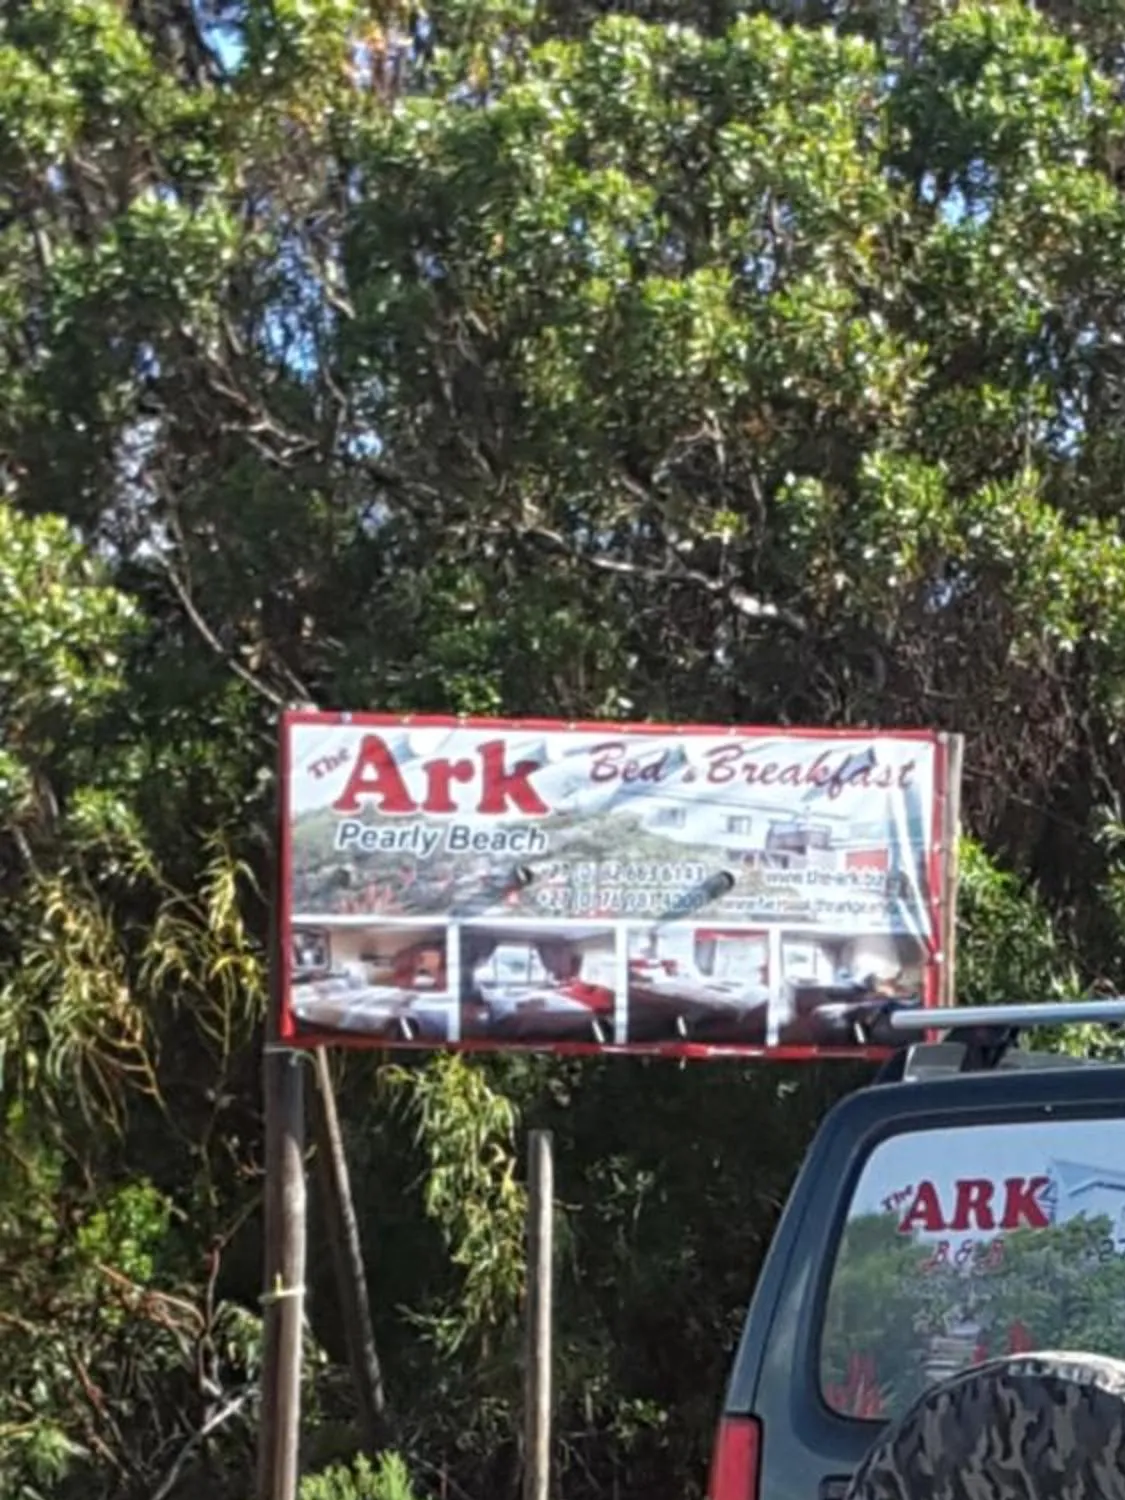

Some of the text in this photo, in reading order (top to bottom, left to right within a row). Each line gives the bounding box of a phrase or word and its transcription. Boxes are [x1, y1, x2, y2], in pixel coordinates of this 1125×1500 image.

[307, 733, 550, 815] The Ark
[588, 741, 672, 784] Bed
[701, 743, 916, 800] Breakfast
[338, 822, 547, 857] Pearly Beach
[898, 1178, 1050, 1232] ARK
